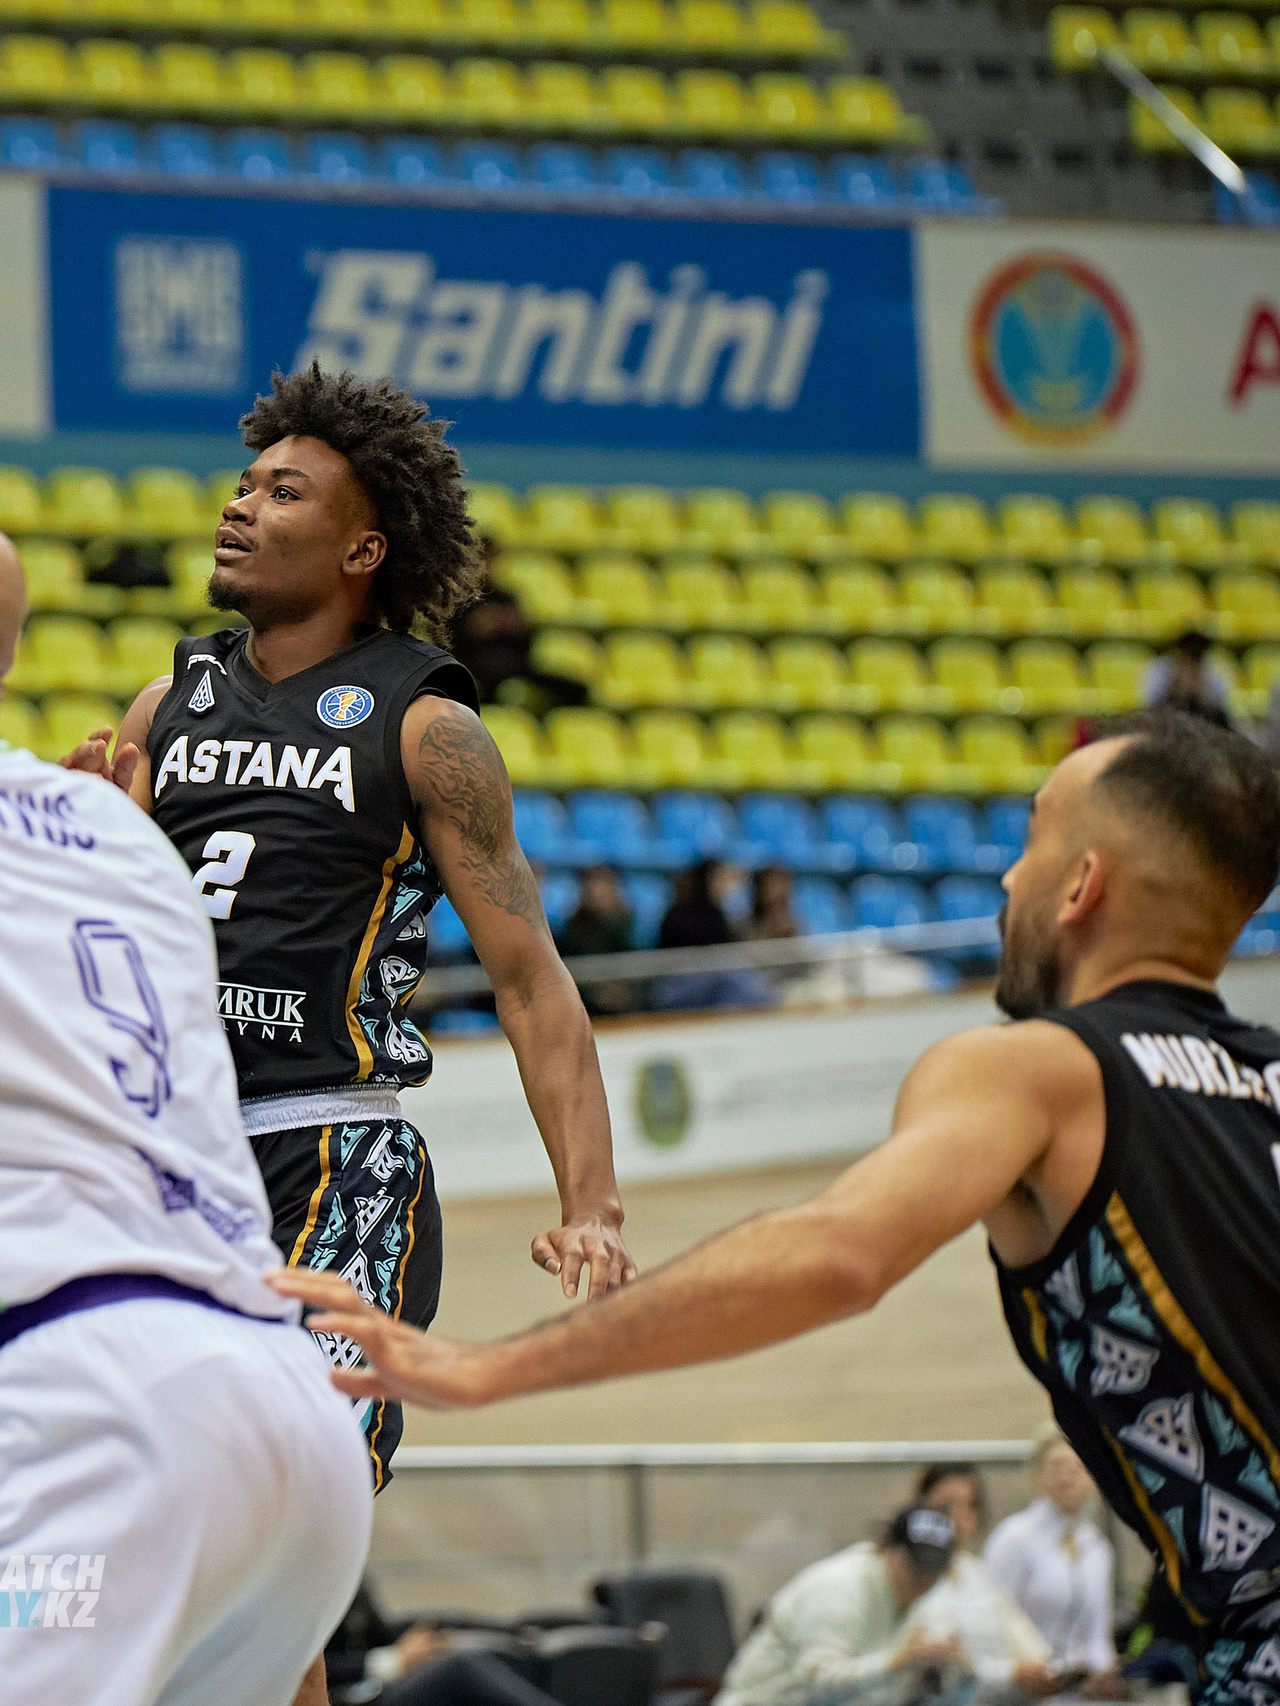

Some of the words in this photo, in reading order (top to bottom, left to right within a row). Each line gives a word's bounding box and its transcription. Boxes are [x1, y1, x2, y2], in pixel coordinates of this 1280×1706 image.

[292, 246, 830, 410] Santini
[154, 735, 355, 813] ASTANA
[193, 830, 257, 920] 2
[70, 917, 172, 1119] 9
